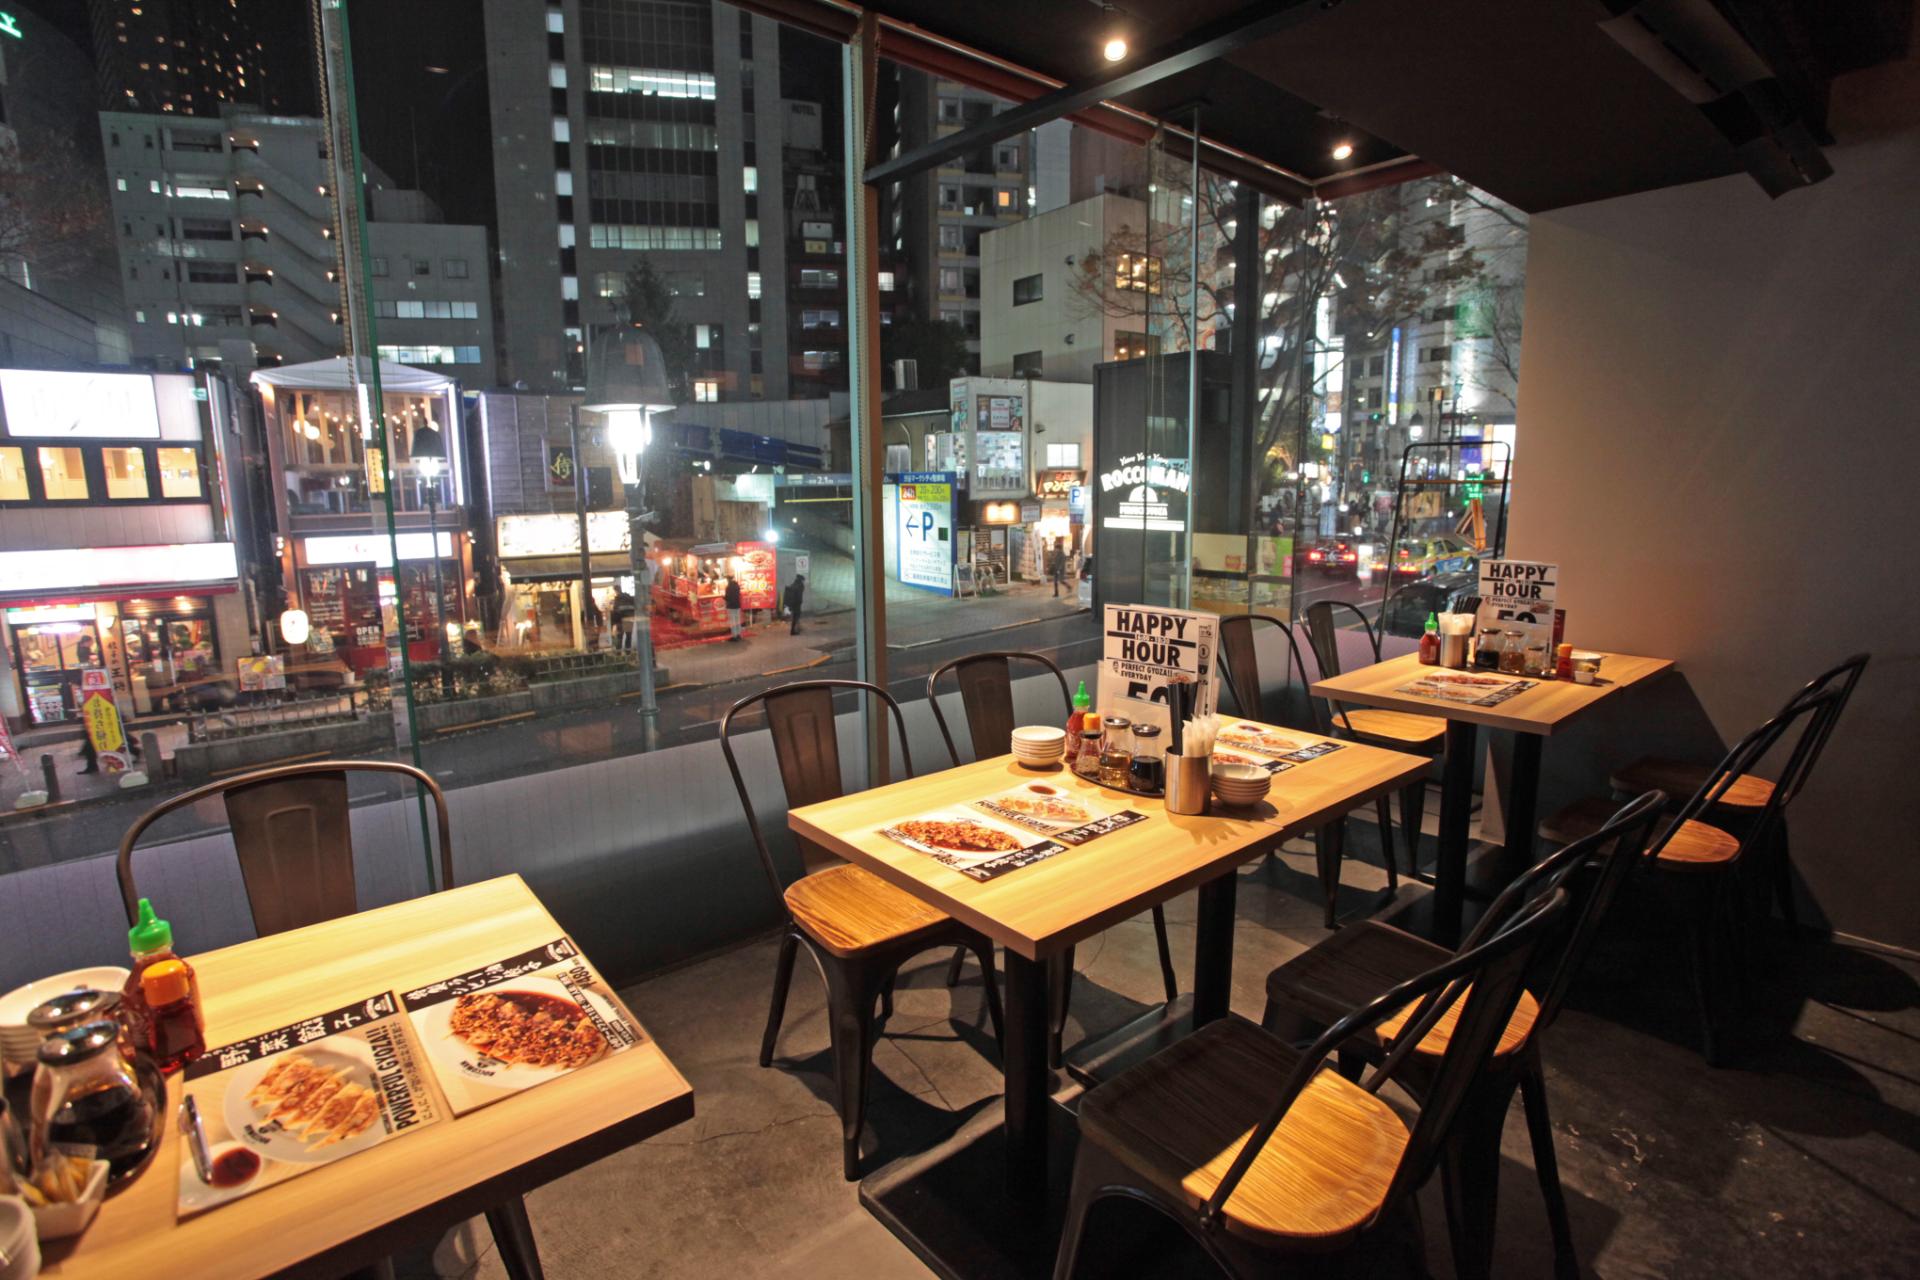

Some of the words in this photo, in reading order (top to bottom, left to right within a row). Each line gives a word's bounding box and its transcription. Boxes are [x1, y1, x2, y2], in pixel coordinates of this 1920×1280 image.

[1071, 488, 1080, 503] P
[922, 511, 934, 541] P
[1490, 563, 1548, 580] HAPPY
[1494, 582, 1542, 599] HOUR
[1117, 611, 1188, 639] HAPPY
[1122, 639, 1181, 667] HOUR
[1120, 670, 1152, 681] EVERYDAY
[1121, 662, 1146, 673] PERFECT
[569, 966, 598, 989] ¥480
[220, 1013, 361, 1069] 野菜餃子
[366, 1025, 399, 1071] GYOZA!!
[381, 1068, 419, 1130] POWERFUL
